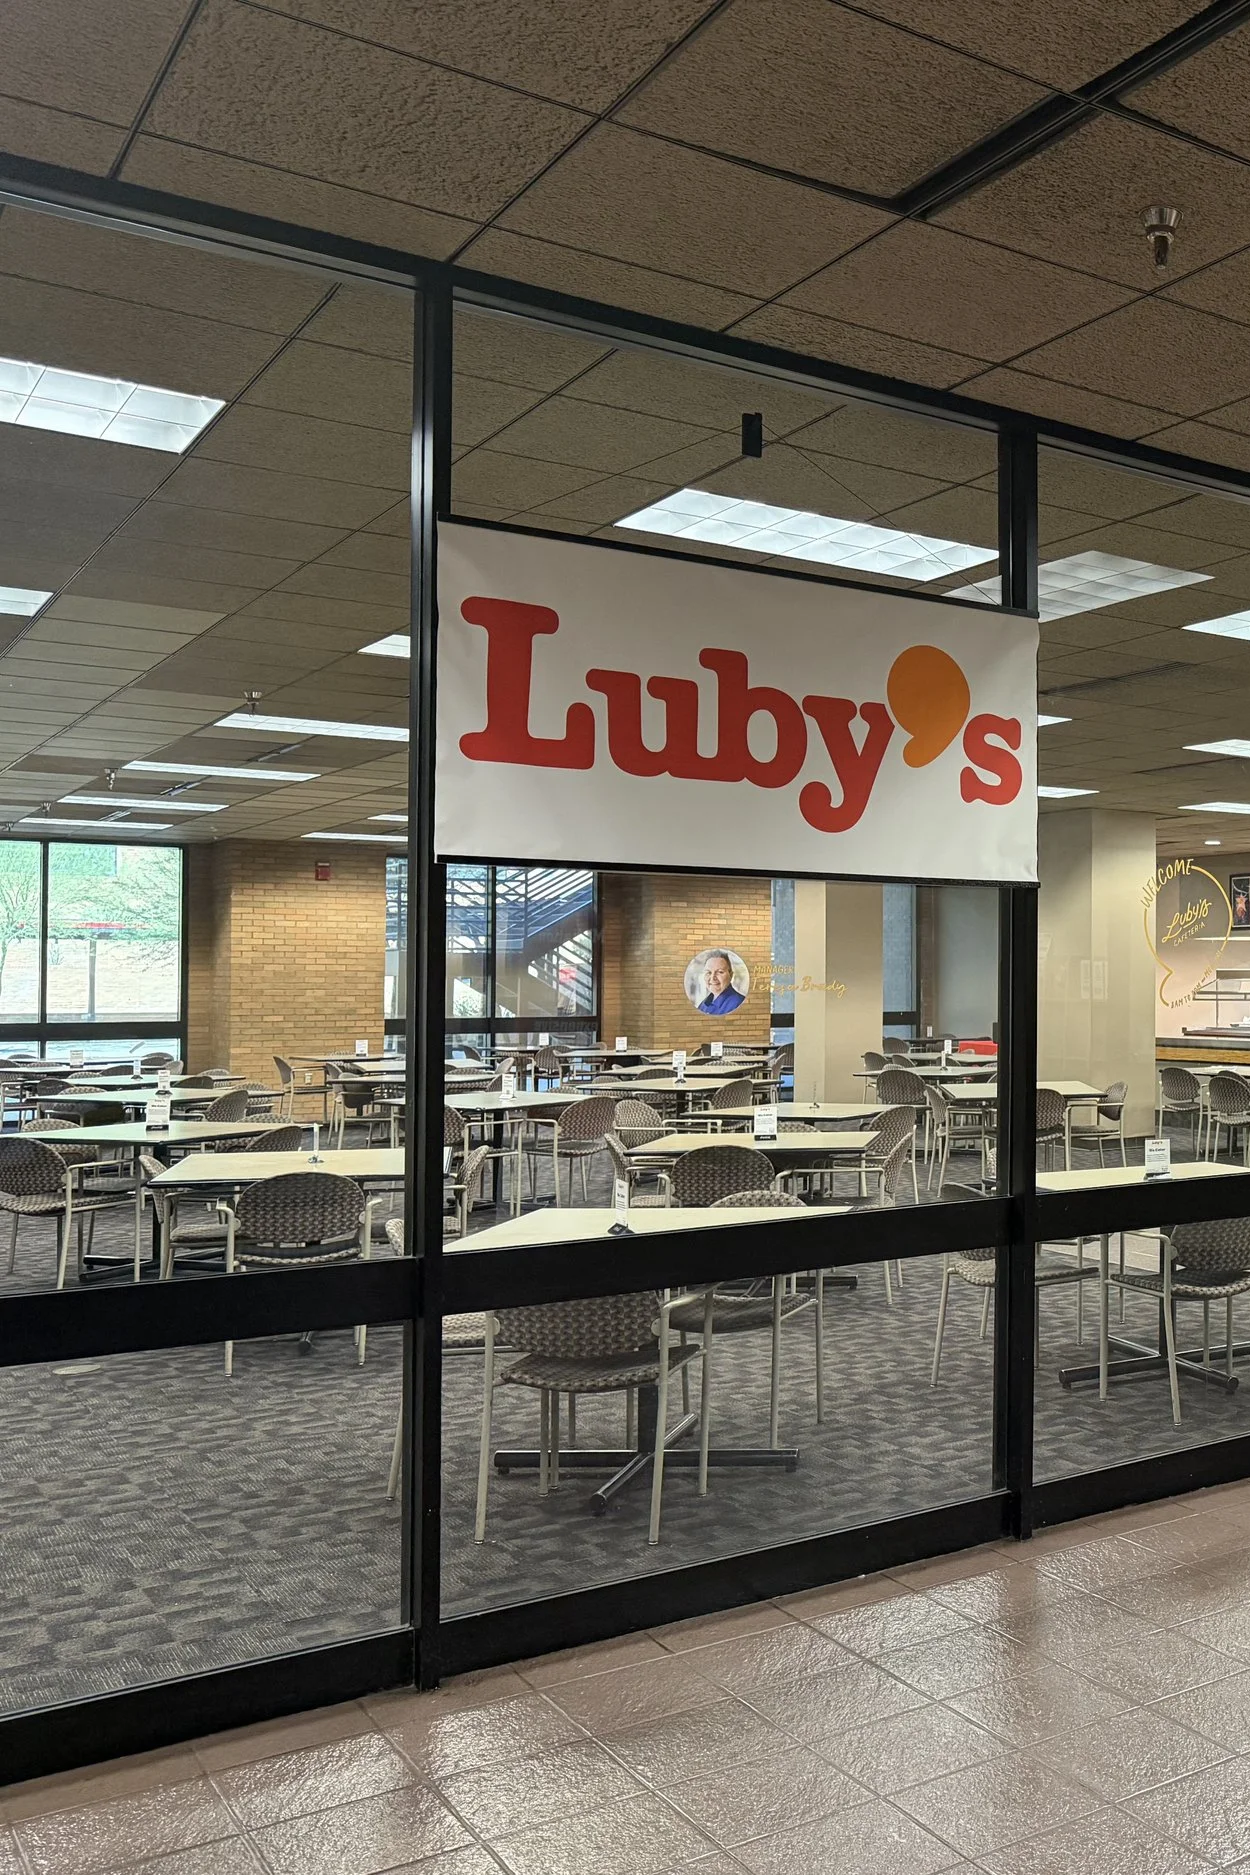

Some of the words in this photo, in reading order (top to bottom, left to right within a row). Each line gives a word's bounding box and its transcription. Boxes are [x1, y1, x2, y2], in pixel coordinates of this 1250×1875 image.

[459, 595, 1023, 833] Luby's
[1140, 858, 1194, 908] WELCOME
[1162, 898, 1213, 943] Luby's
[1173, 921, 1206, 947] CAFETERIA
[753, 964, 794, 975] MANAGER
